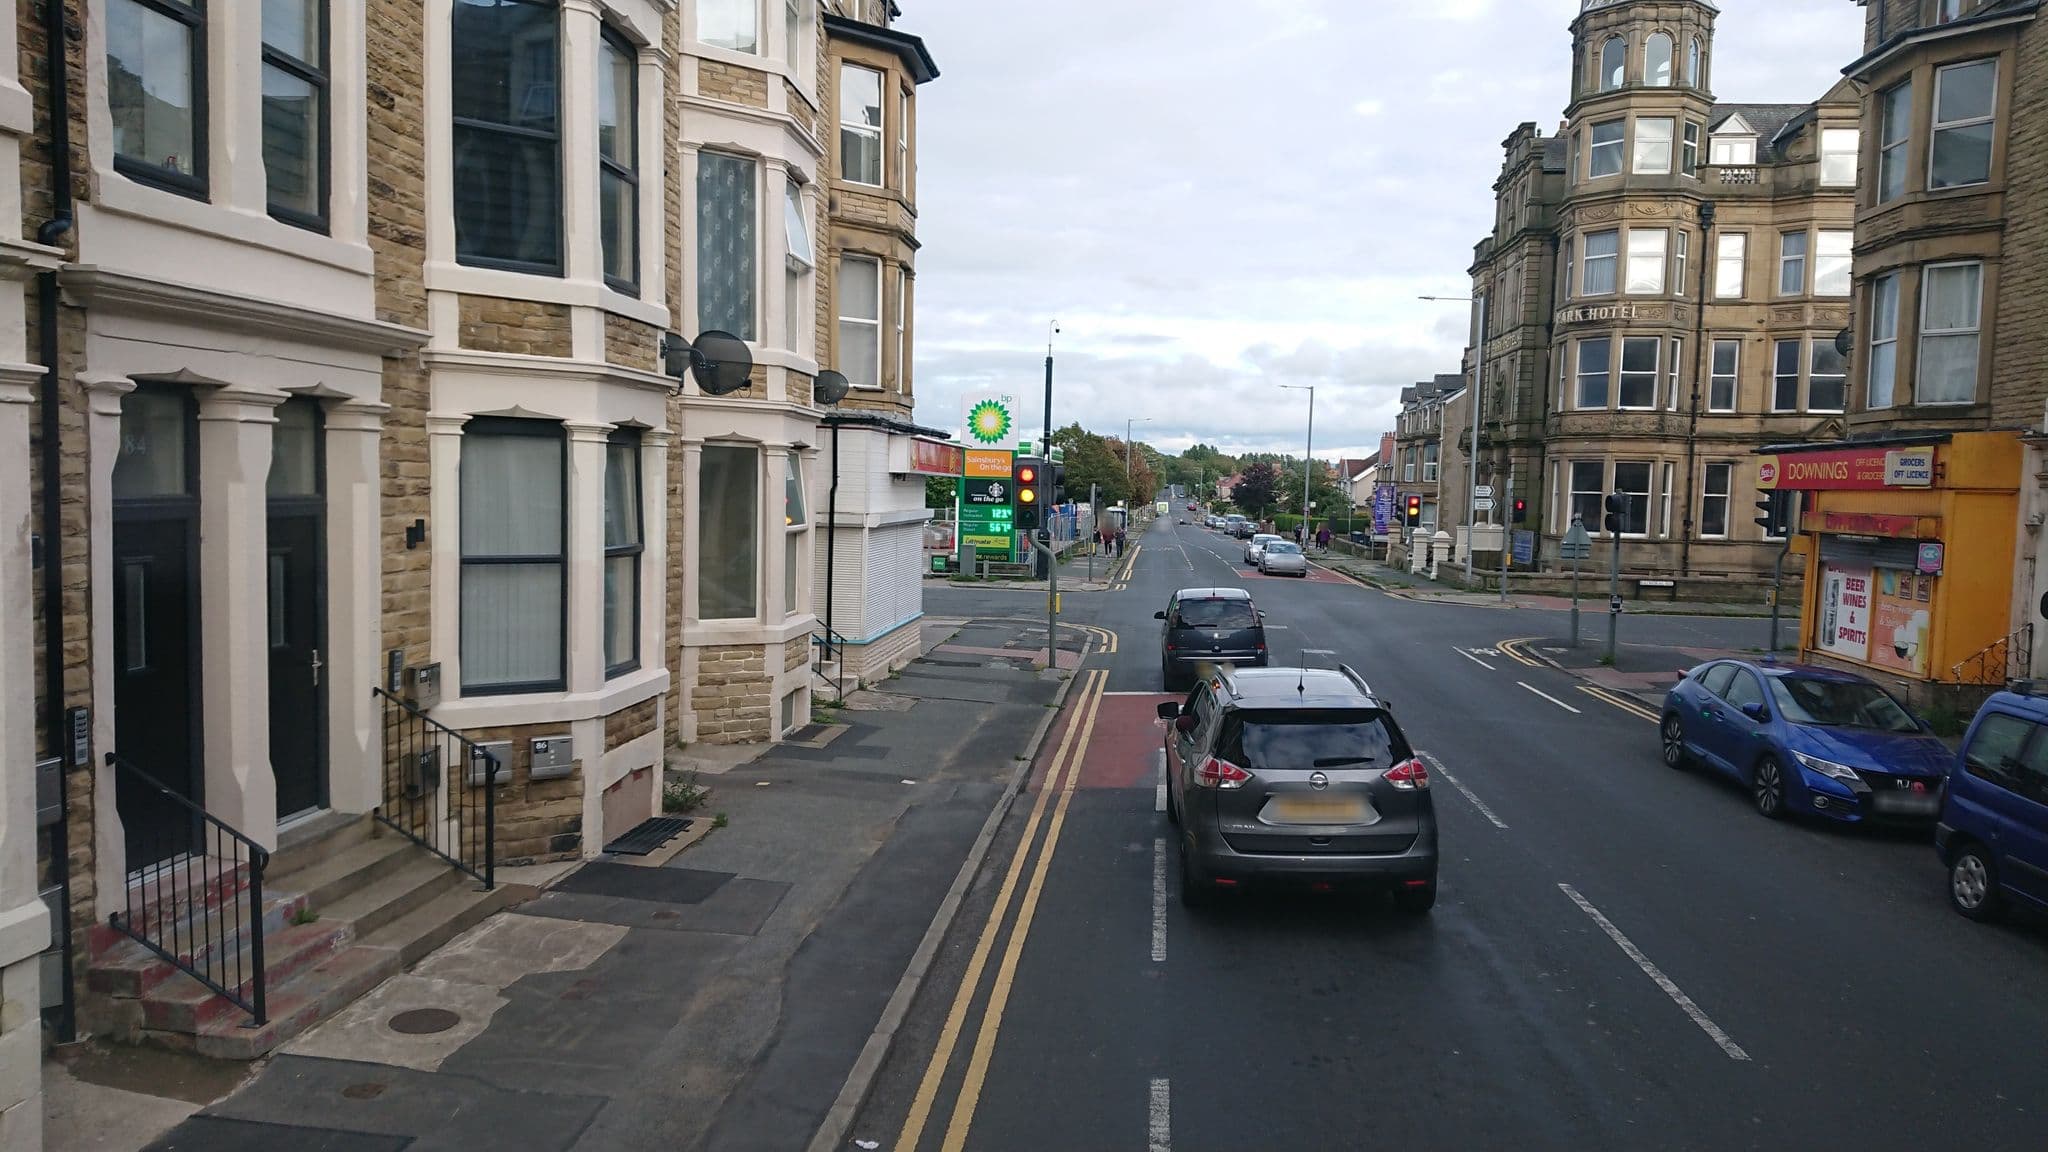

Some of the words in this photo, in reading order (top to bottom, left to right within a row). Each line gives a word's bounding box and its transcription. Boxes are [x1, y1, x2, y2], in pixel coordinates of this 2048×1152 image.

[1589, 306, 1640, 321] HOTEL
[1001, 394, 1013, 404] bp
[979, 463, 990, 471] On
[1866, 457, 1885, 467] LICENC
[1899, 458, 1926, 467] GROCERS
[1788, 461, 1849, 480] DOWNINGS
[1893, 470, 1905, 478] OFF
[1906, 470, 1929, 479] LICENCE
[1845, 577, 1866, 593] BEER
[1842, 592, 1867, 609] WINES
[1849, 610, 1856, 624] &
[1838, 626, 1867, 645] SPIRITS
[535, 742, 548, 750] 86
